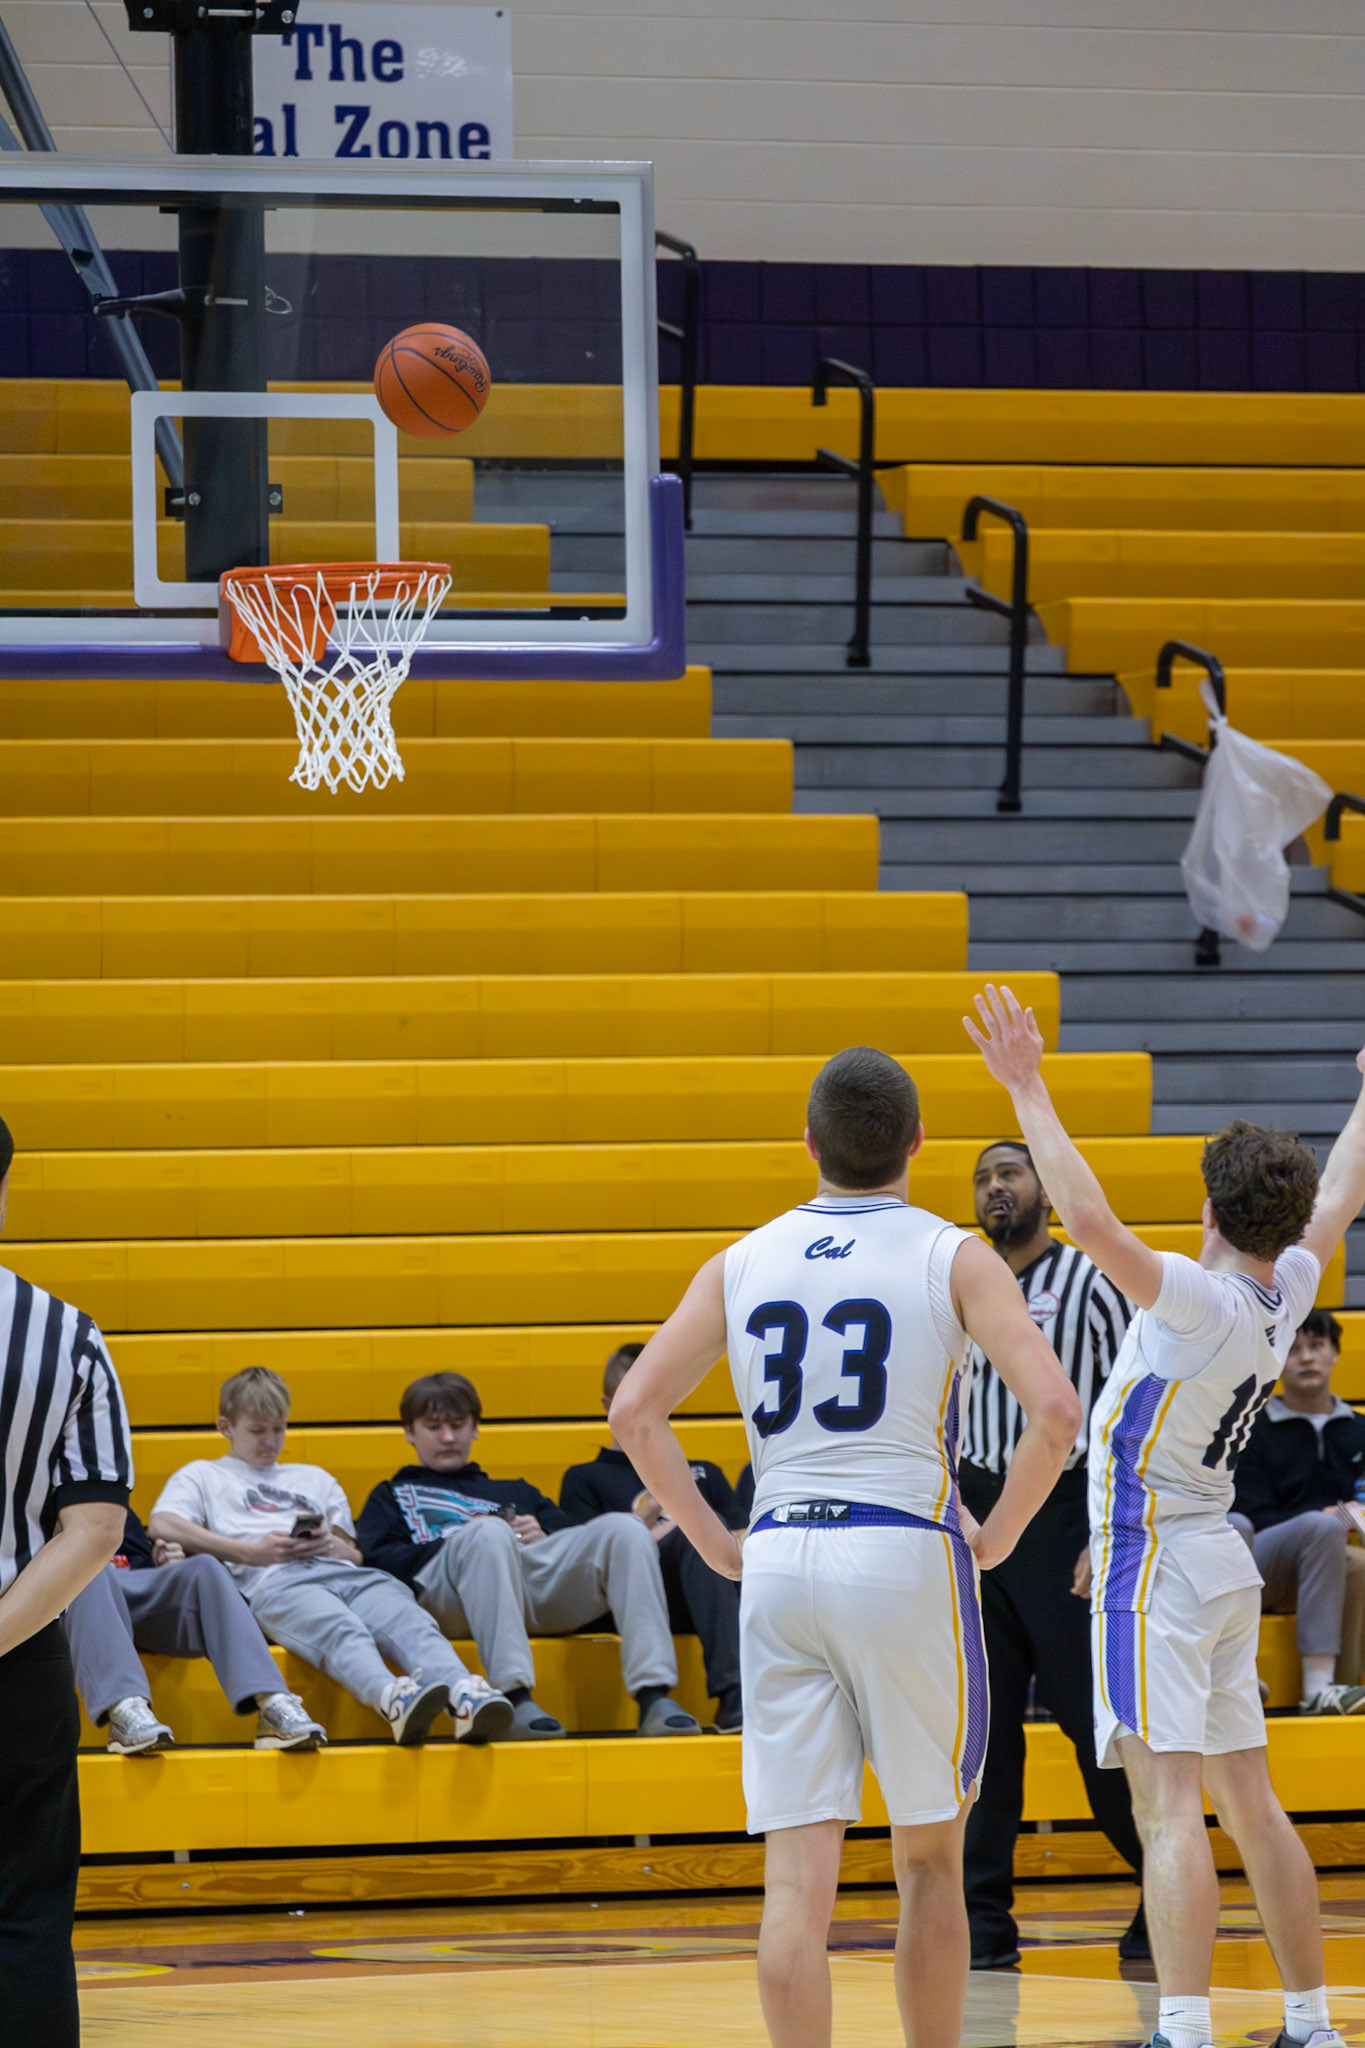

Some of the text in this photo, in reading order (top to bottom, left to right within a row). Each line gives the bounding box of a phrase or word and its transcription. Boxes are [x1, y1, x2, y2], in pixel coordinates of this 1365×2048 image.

[281, 23, 404, 82] The
[334, 105, 491, 159] Zone
[804, 1236, 856, 1260] Cal
[745, 1298, 892, 1439] 33
